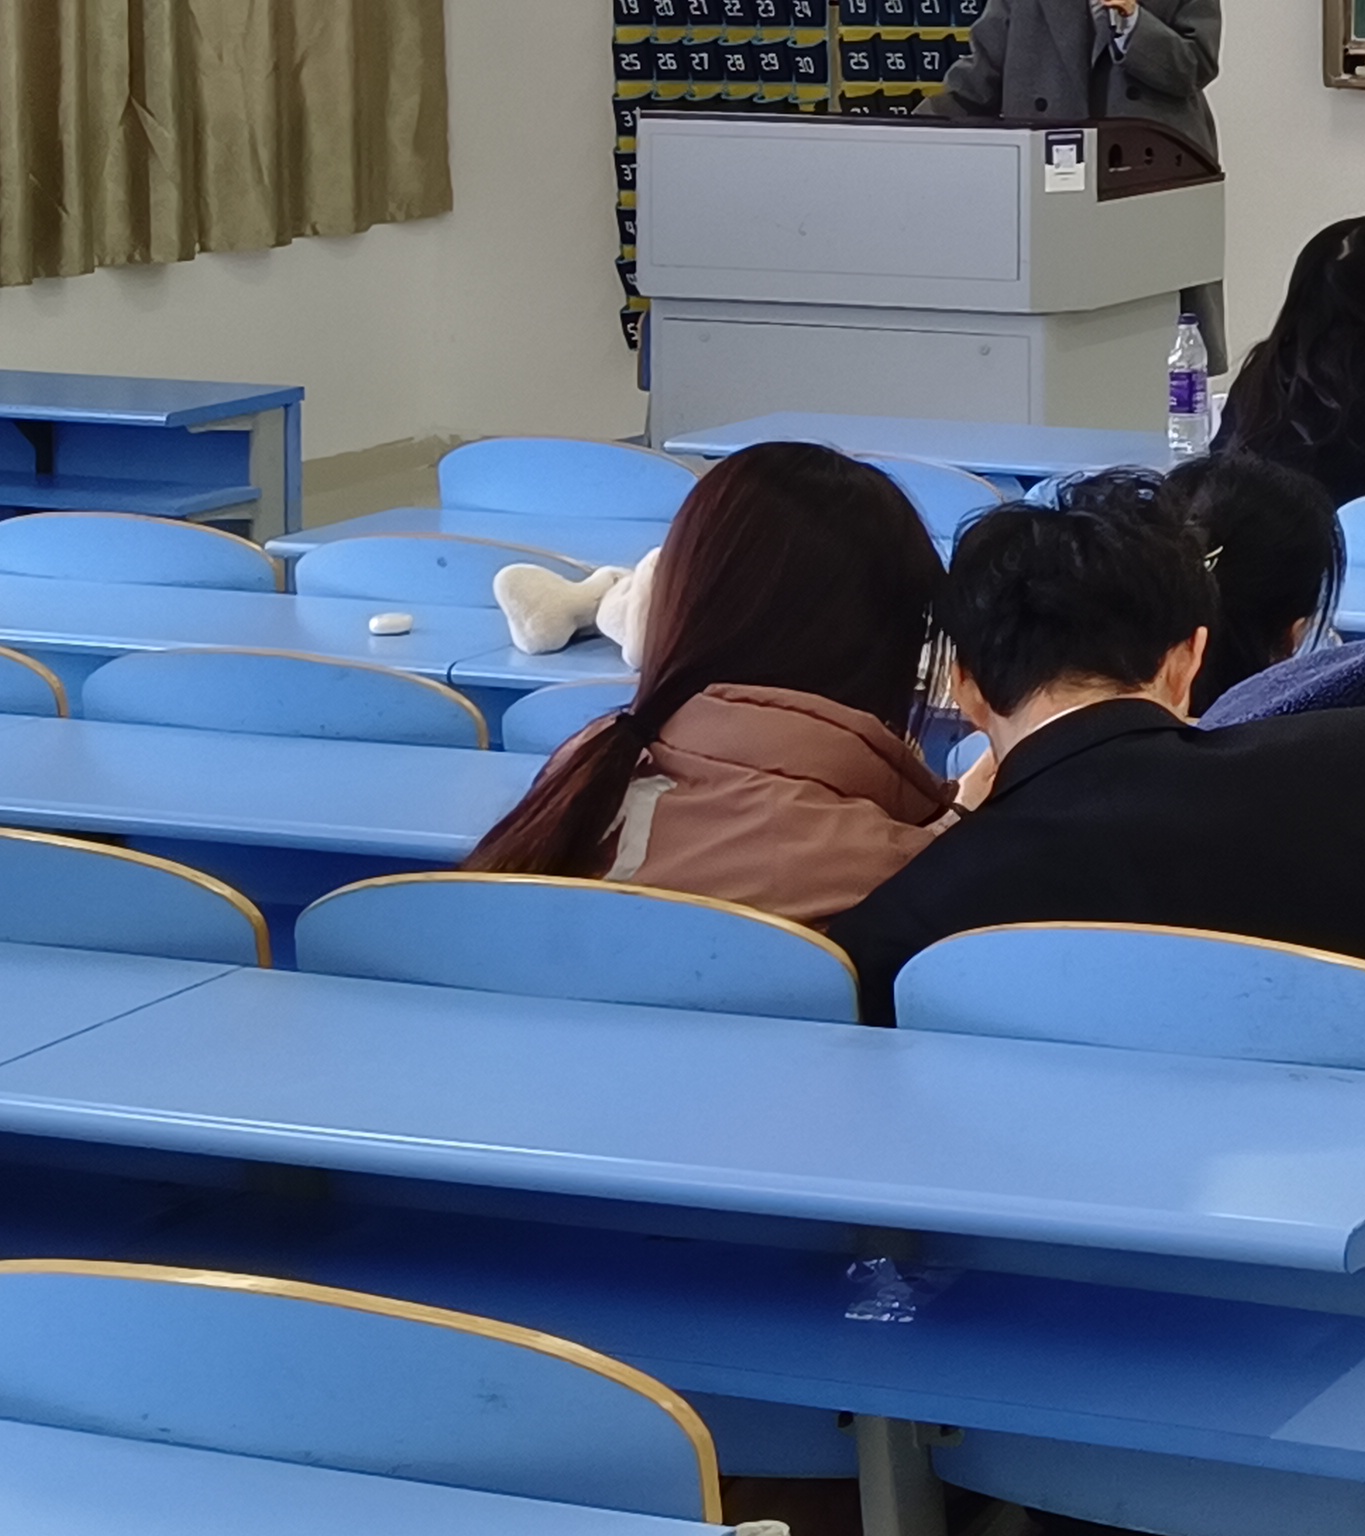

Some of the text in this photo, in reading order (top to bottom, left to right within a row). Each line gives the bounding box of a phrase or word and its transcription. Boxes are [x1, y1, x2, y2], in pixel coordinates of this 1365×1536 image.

[723, 0, 744, 16] 22
[756, 0, 775, 17] 23
[792, 0, 811, 18] 24
[619, 52, 814, 74] 25 26 27 28 29 30
[849, 52, 940, 70] 25 26 27
